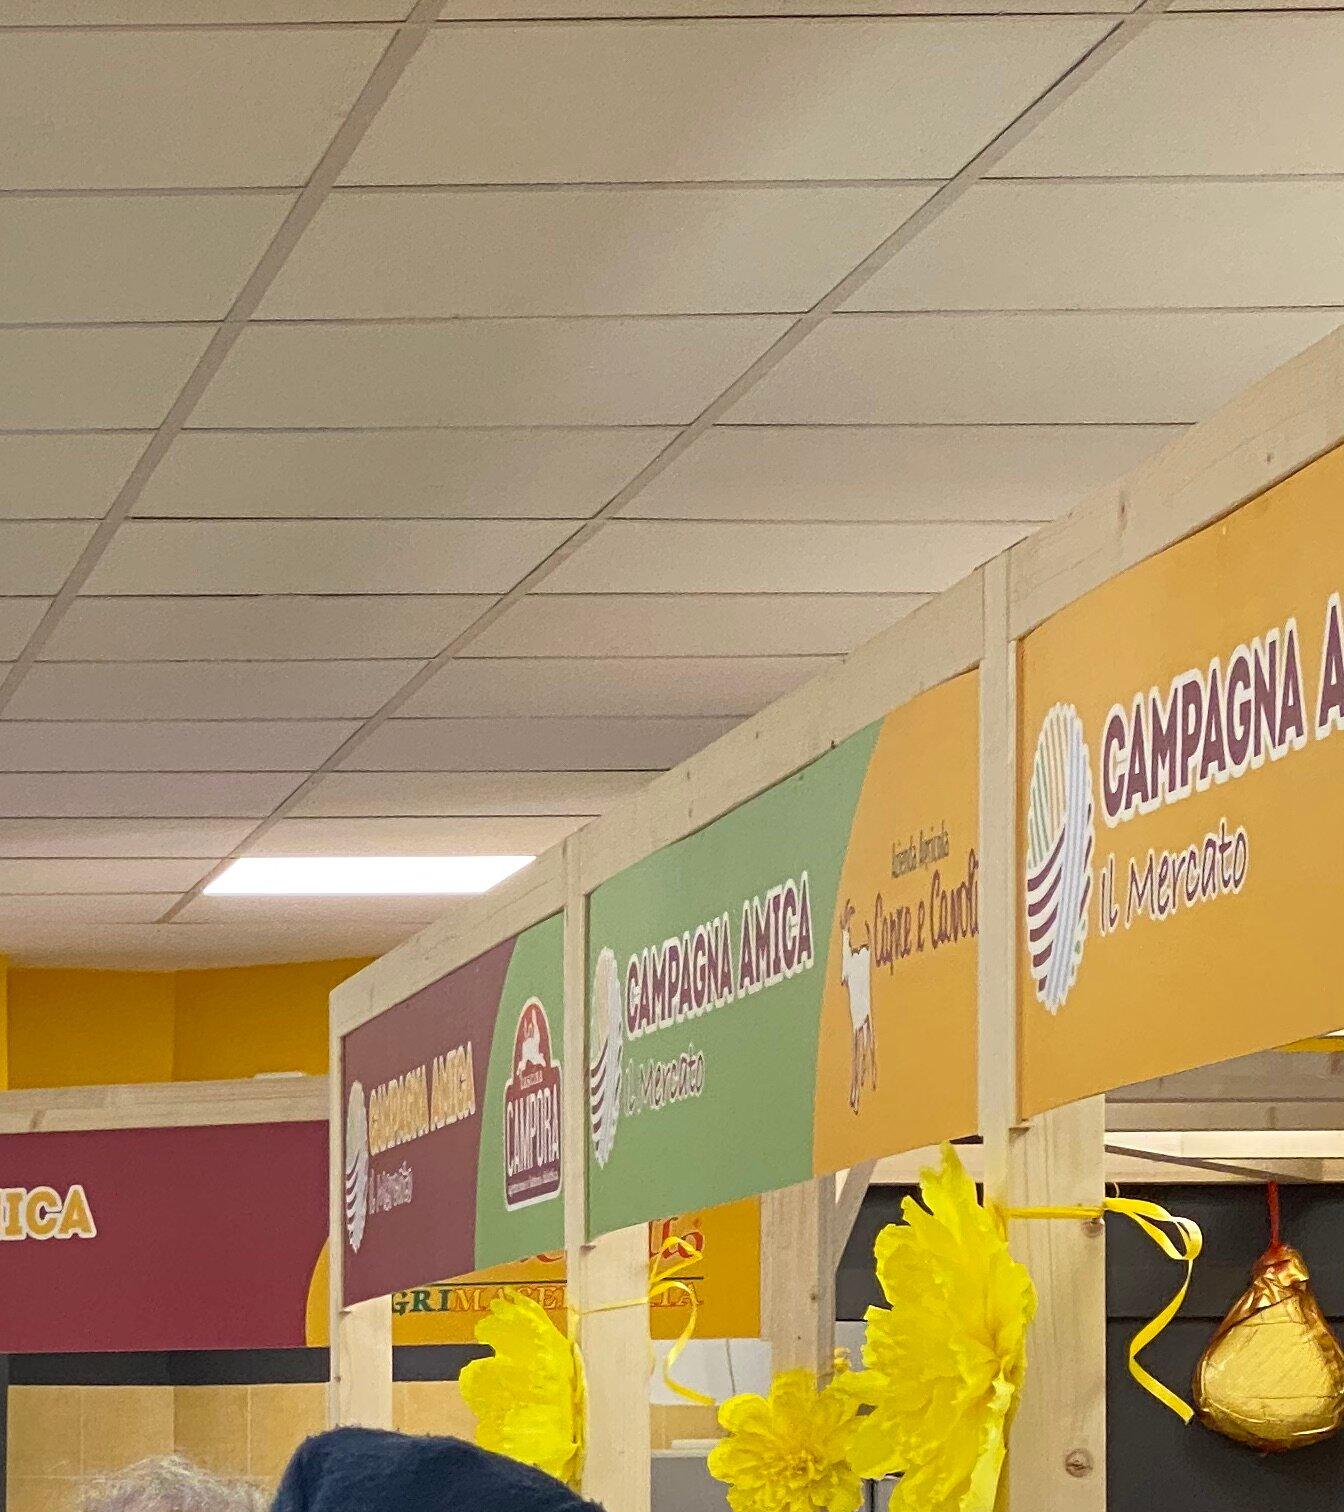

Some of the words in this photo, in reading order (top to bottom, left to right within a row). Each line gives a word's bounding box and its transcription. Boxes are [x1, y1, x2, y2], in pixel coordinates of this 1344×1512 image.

[1100, 617, 1307, 828] CAMPAGNA
[874, 892, 912, 976] Capre
[917, 901, 925, 952] e
[1100, 853, 1119, 937] Il
[1125, 816, 1248, 930] Mercato
[625, 911, 735, 1041] CAMPAGNA
[737, 870, 814, 999] AMICA
[369, 1064, 430, 1156] CAMPAGNA
[430, 1041, 476, 1131] AMICA
[506, 1084, 560, 1178] CAMPORA
[641, 1042, 705, 1111] Mercato
